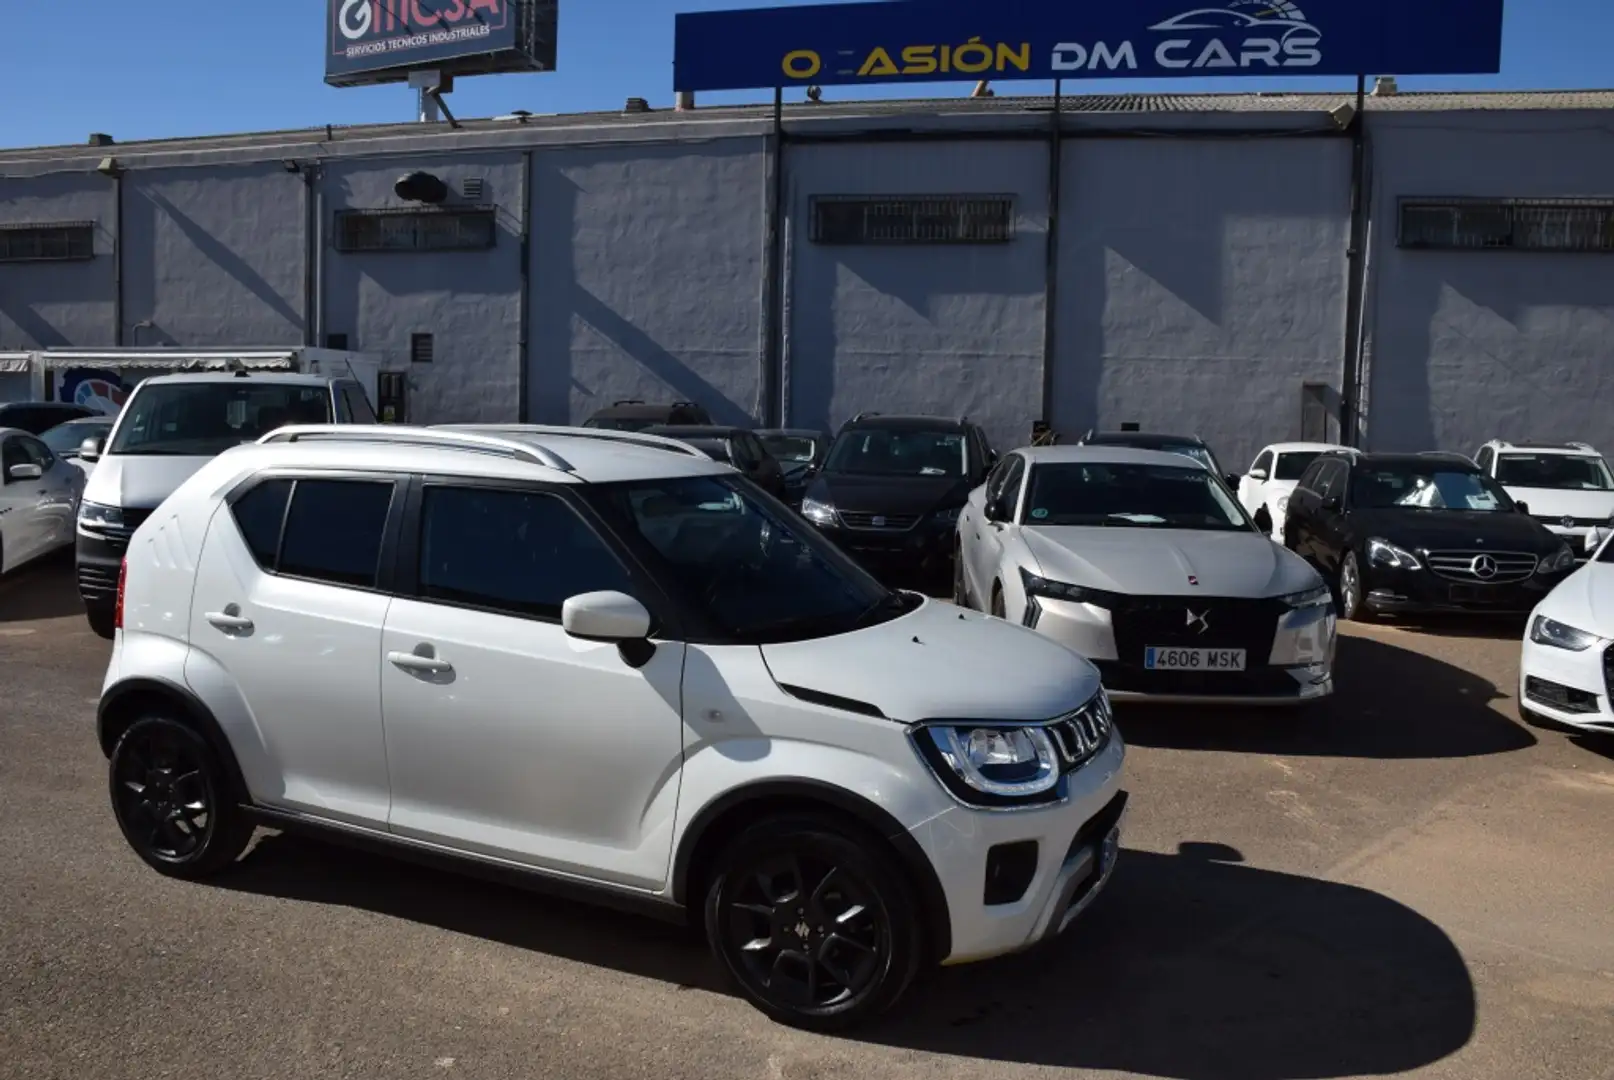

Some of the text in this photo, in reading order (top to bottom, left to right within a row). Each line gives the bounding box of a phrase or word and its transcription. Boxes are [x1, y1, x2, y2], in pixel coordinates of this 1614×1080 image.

[346, 25, 490, 57] SERVICIOS TECNICOS INDUSTRIALES
[1051, 40, 1137, 71] DM
[1154, 37, 1322, 68] CARS
[1157, 650, 1242, 668] 4606 MSK
